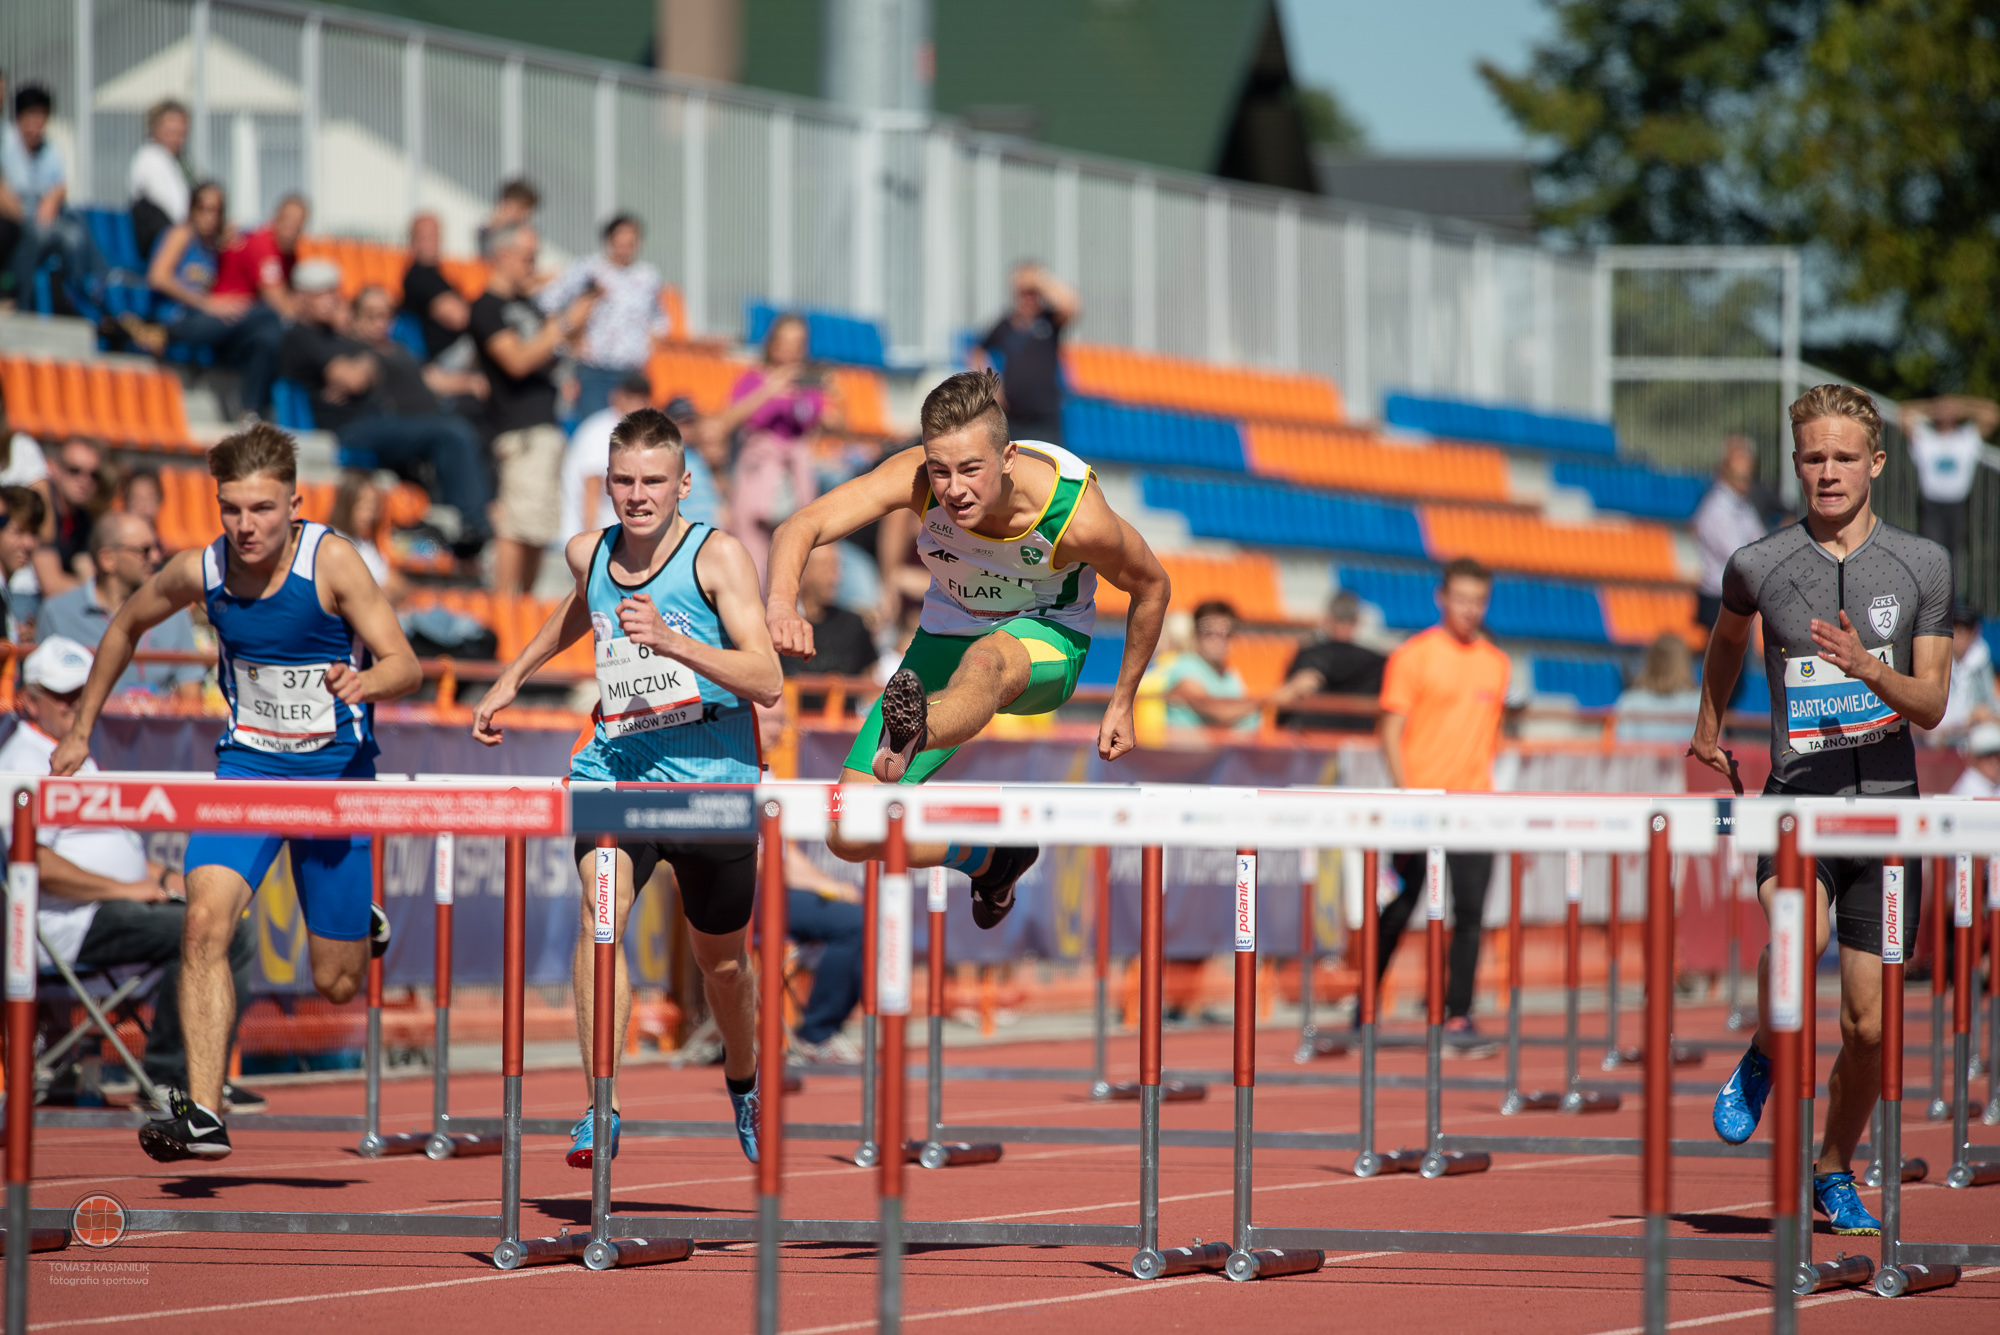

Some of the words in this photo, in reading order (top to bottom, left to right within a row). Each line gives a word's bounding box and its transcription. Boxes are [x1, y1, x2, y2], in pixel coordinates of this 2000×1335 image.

[948, 578, 1003, 600] FILAR
[1875, 598, 1893, 607] CKS
[283, 669, 327, 689] 377
[608, 671, 681, 700] MILCZUK
[253, 700, 312, 720] SZYLER
[1790, 692, 1885, 718] BARTŁOMIEJCZ
[617, 716, 660, 735] TARNÓW
[663, 711, 687, 725] 2019
[1808, 734, 1859, 750] TARNÓW
[1862, 729, 1888, 743] 2019
[45, 784, 177, 823] PZLA
[596, 872, 610, 926] polanik
[1237, 880, 1251, 933] polanik
[1885, 891, 1900, 946] polanik
